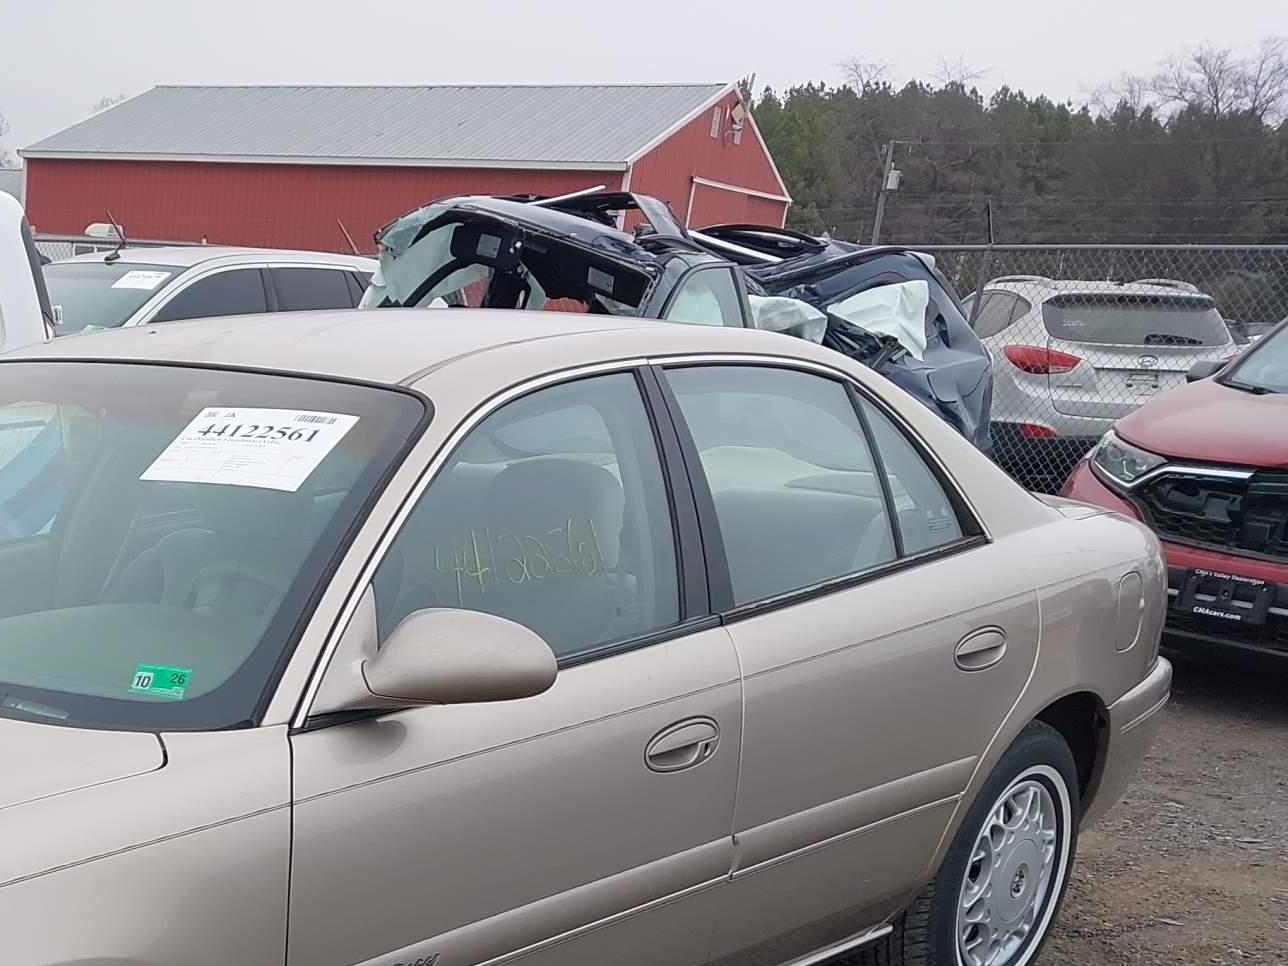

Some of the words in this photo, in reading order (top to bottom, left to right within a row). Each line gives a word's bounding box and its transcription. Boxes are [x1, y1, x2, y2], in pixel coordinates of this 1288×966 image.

[198, 423, 321, 443] 44122561
[135, 675, 152, 688] 10
[170, 673, 187, 685] 26
